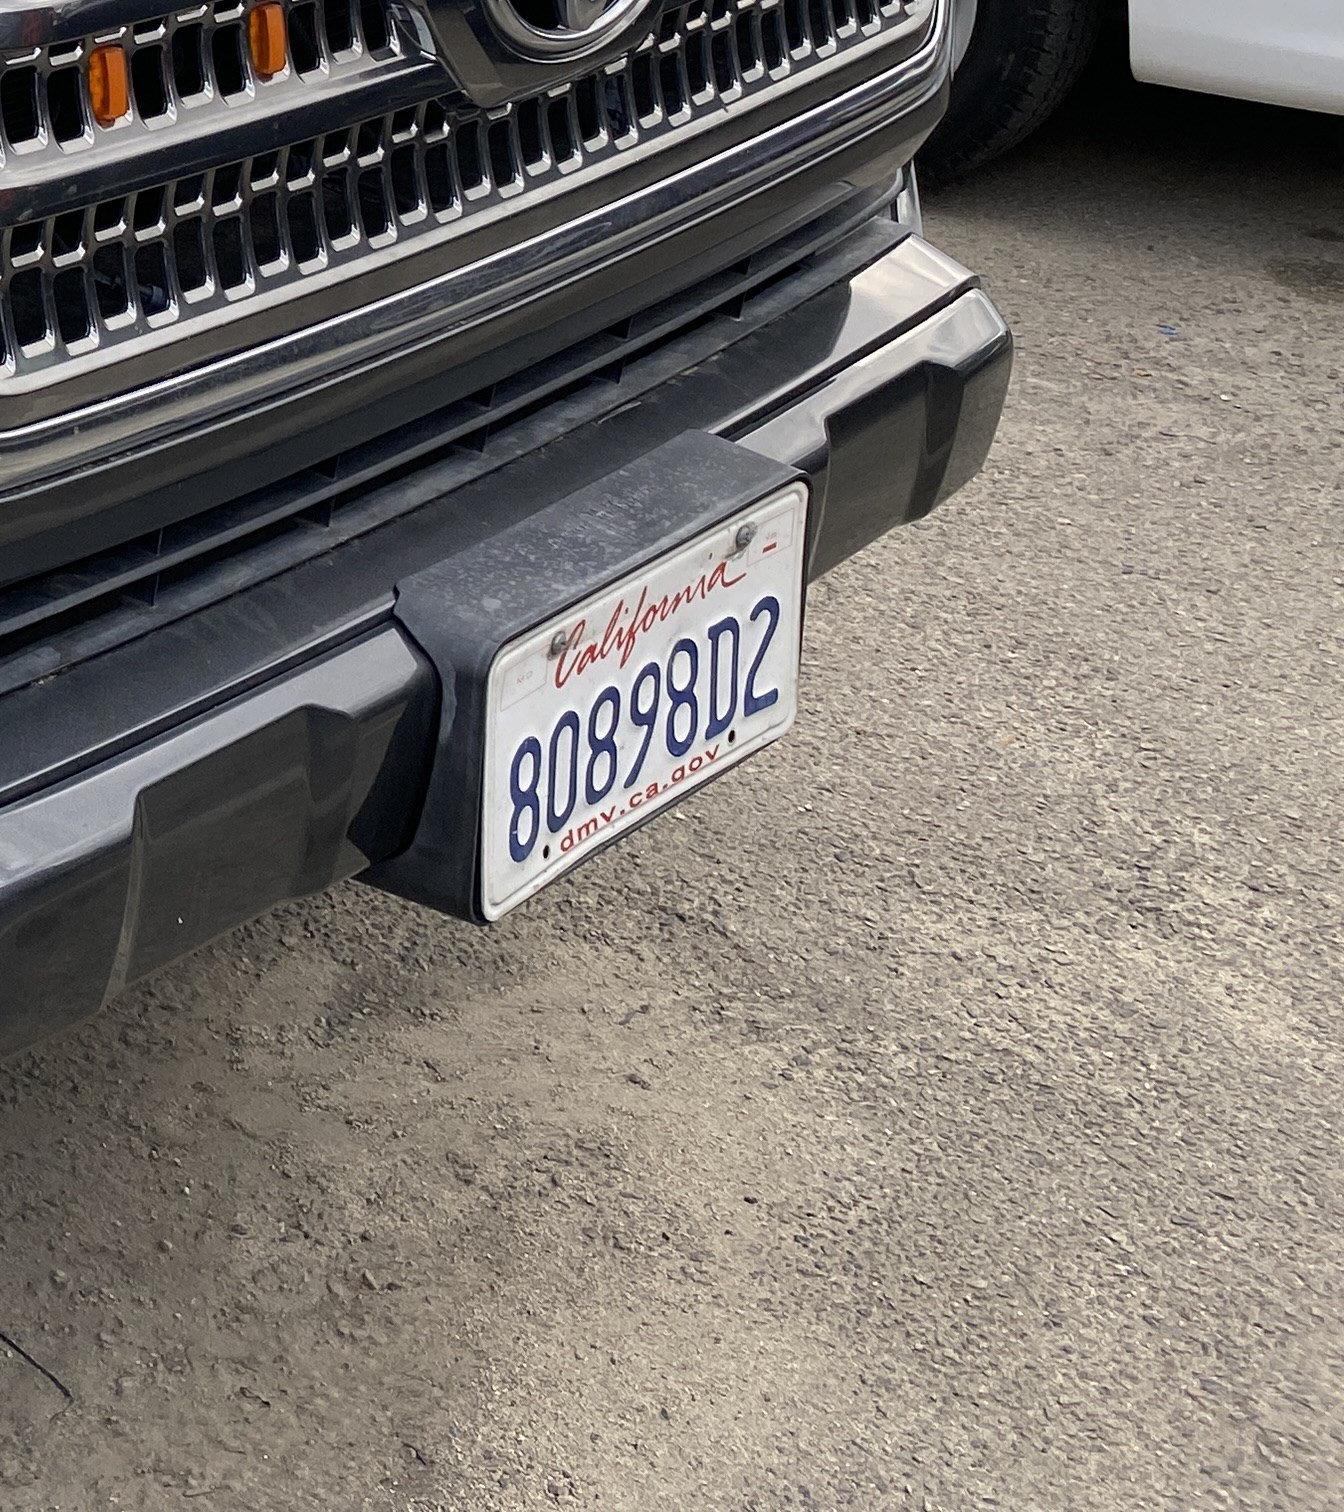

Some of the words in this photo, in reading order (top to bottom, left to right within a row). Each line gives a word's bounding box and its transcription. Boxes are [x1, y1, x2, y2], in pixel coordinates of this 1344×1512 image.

[554, 552, 747, 689] California
[508, 595, 781, 864] 80898D2
[560, 744, 720, 853] dmv.ca.gov
